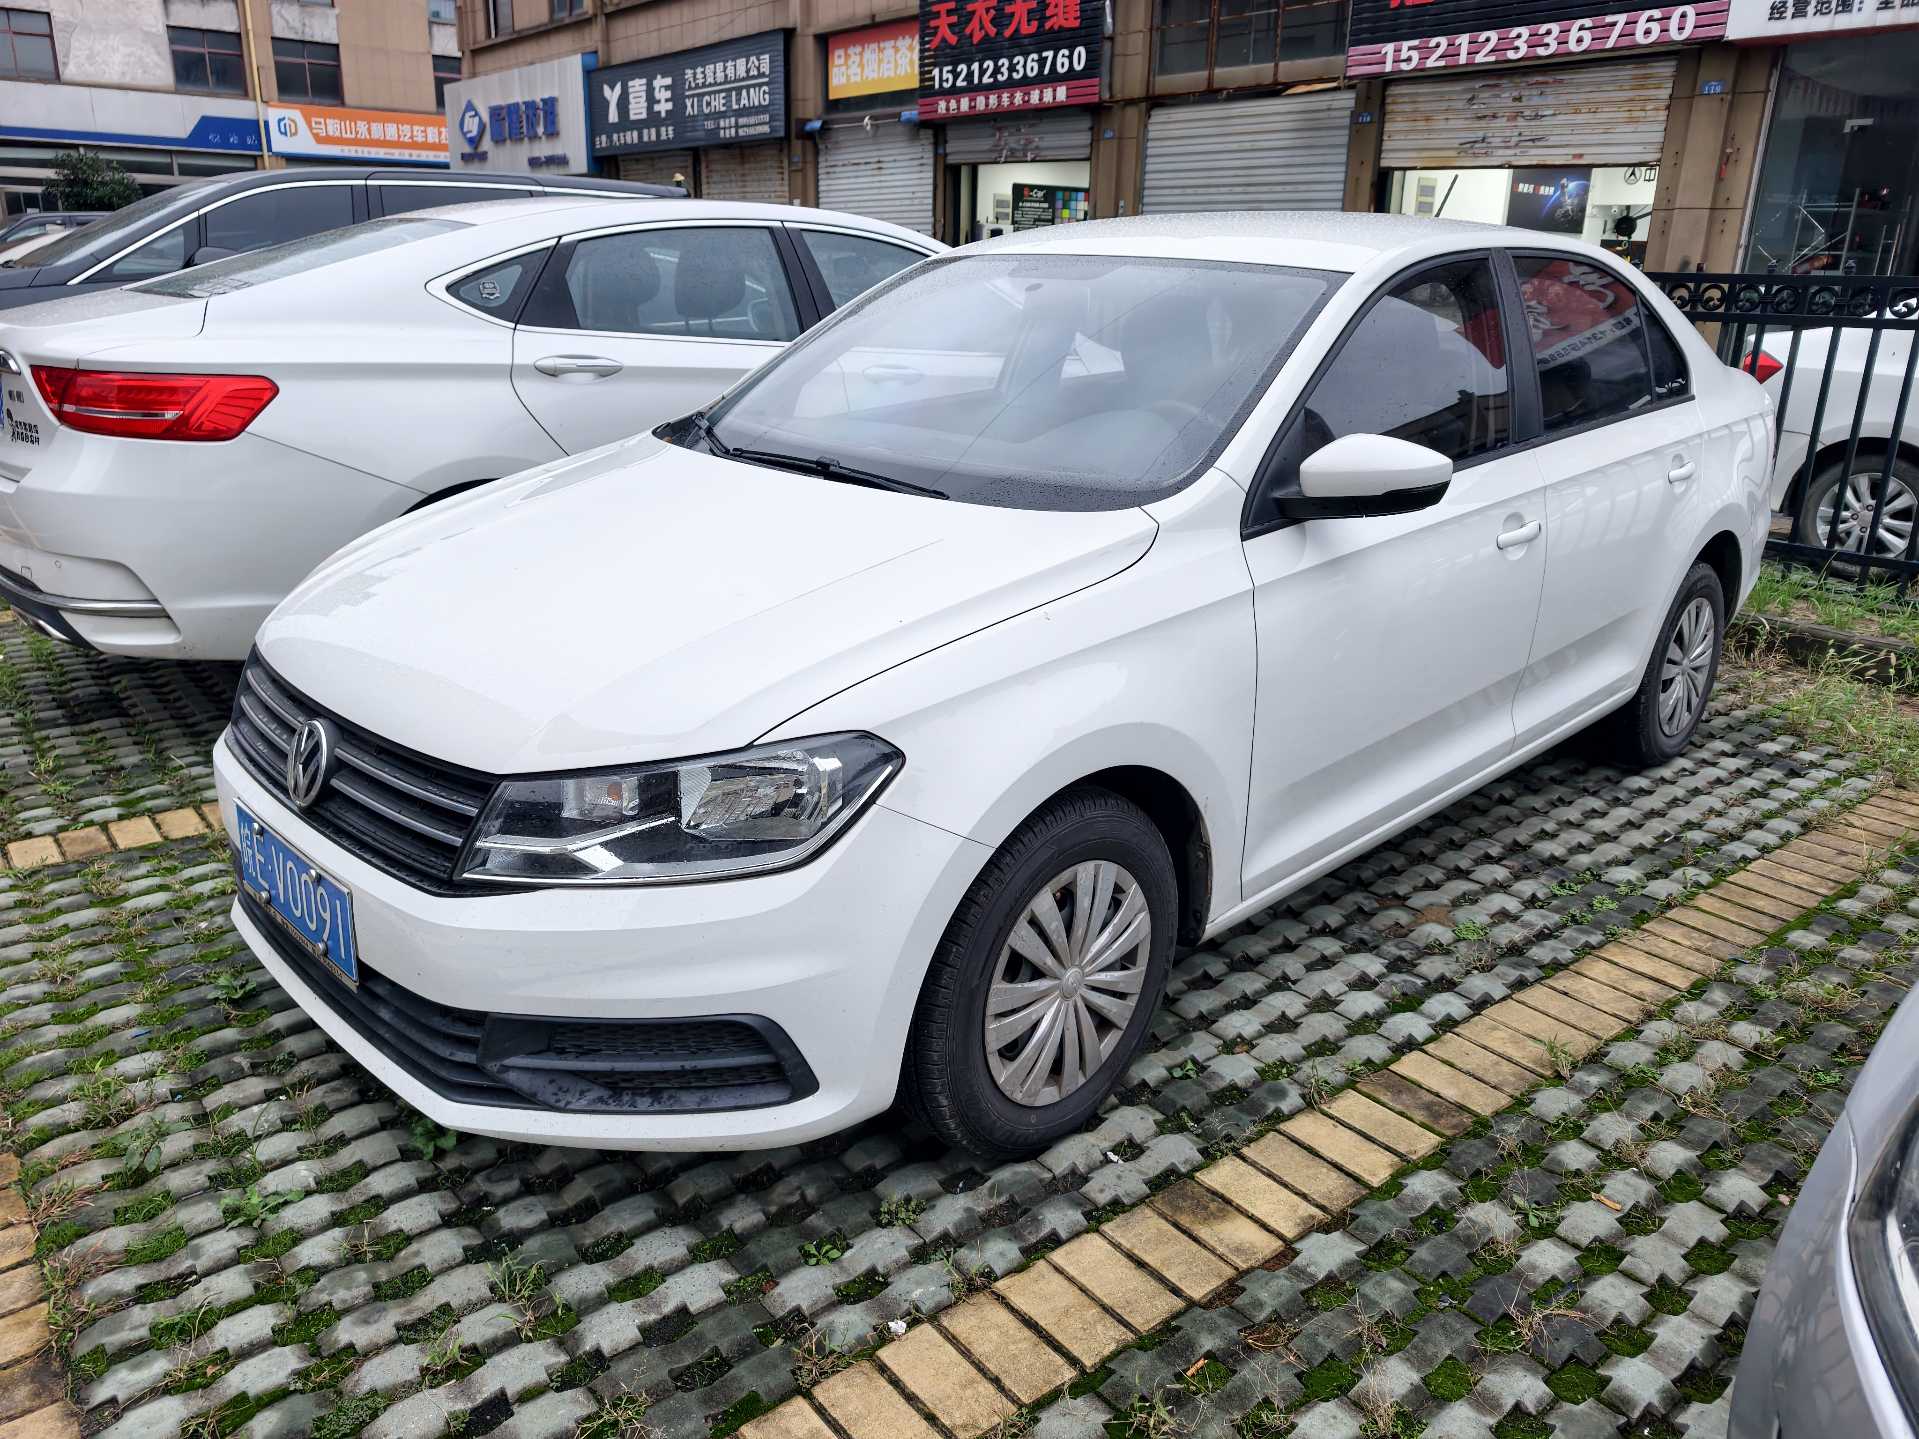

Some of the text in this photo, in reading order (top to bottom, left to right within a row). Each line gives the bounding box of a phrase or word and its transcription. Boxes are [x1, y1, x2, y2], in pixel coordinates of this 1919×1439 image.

[929, 0, 1081, 49] 天衣无缝
[1381, 5, 1696, 73] 15212336760
[684, 54, 770, 90] 汽车贸易有限公司
[931, 46, 1087, 90] 15212336760
[685, 86, 770, 117] XI CHE LANG
